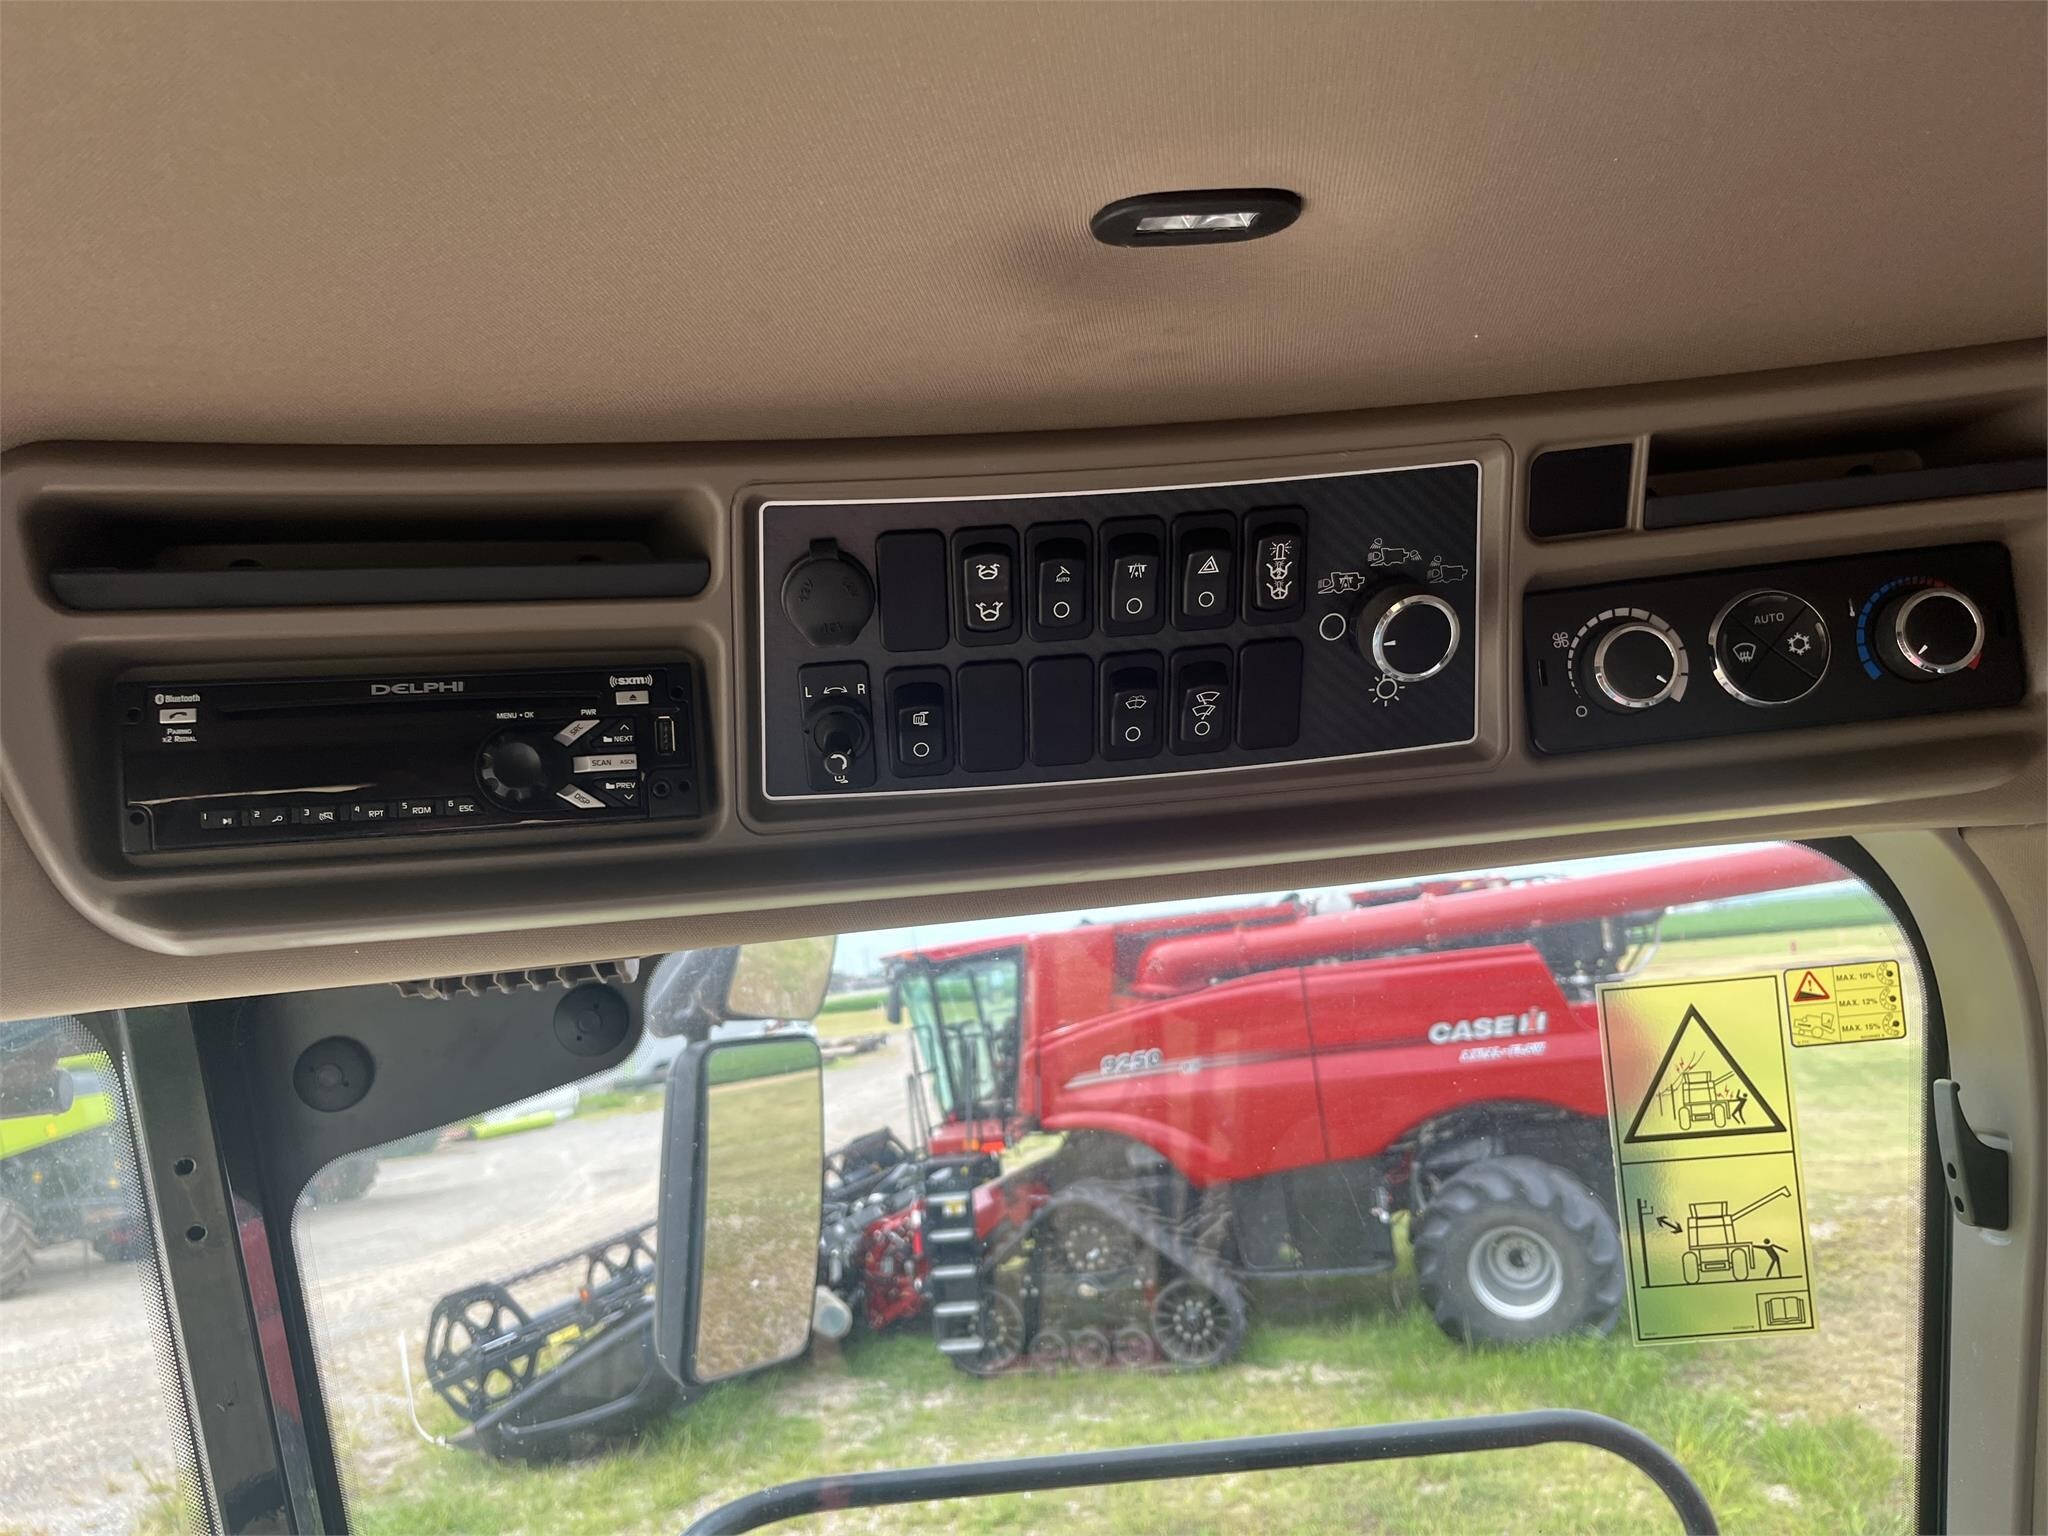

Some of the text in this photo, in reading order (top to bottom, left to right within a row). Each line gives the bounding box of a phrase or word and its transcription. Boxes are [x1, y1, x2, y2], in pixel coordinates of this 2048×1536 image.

[1753, 611, 1786, 625] AUTO
[371, 681, 464, 695] DELPHI
[805, 686, 811, 698] L
[857, 684, 865, 694] R
[165, 694, 201, 703] Bluetooth
[496, 711, 534, 720] MENU OK
[580, 708, 597, 716] PWR
[569, 723, 585, 737] SRC
[614, 735, 633, 743] NEXT
[591, 759, 612, 767] SCAN
[616, 782, 636, 790] PREV
[574, 792, 591, 805] DISP
[401, 802, 408, 810] 5
[448, 800, 474, 813] 6 ESC
[254, 810, 261, 818] 2
[304, 808, 310, 816] 3
[354, 805, 384, 818] 4 RPT
[1836, 973, 1857, 982] MAX.
[1839, 999, 1860, 1007] MAX.
[1428, 1014, 1516, 1044] CASE
[1842, 1024, 1862, 1032] MAX.
